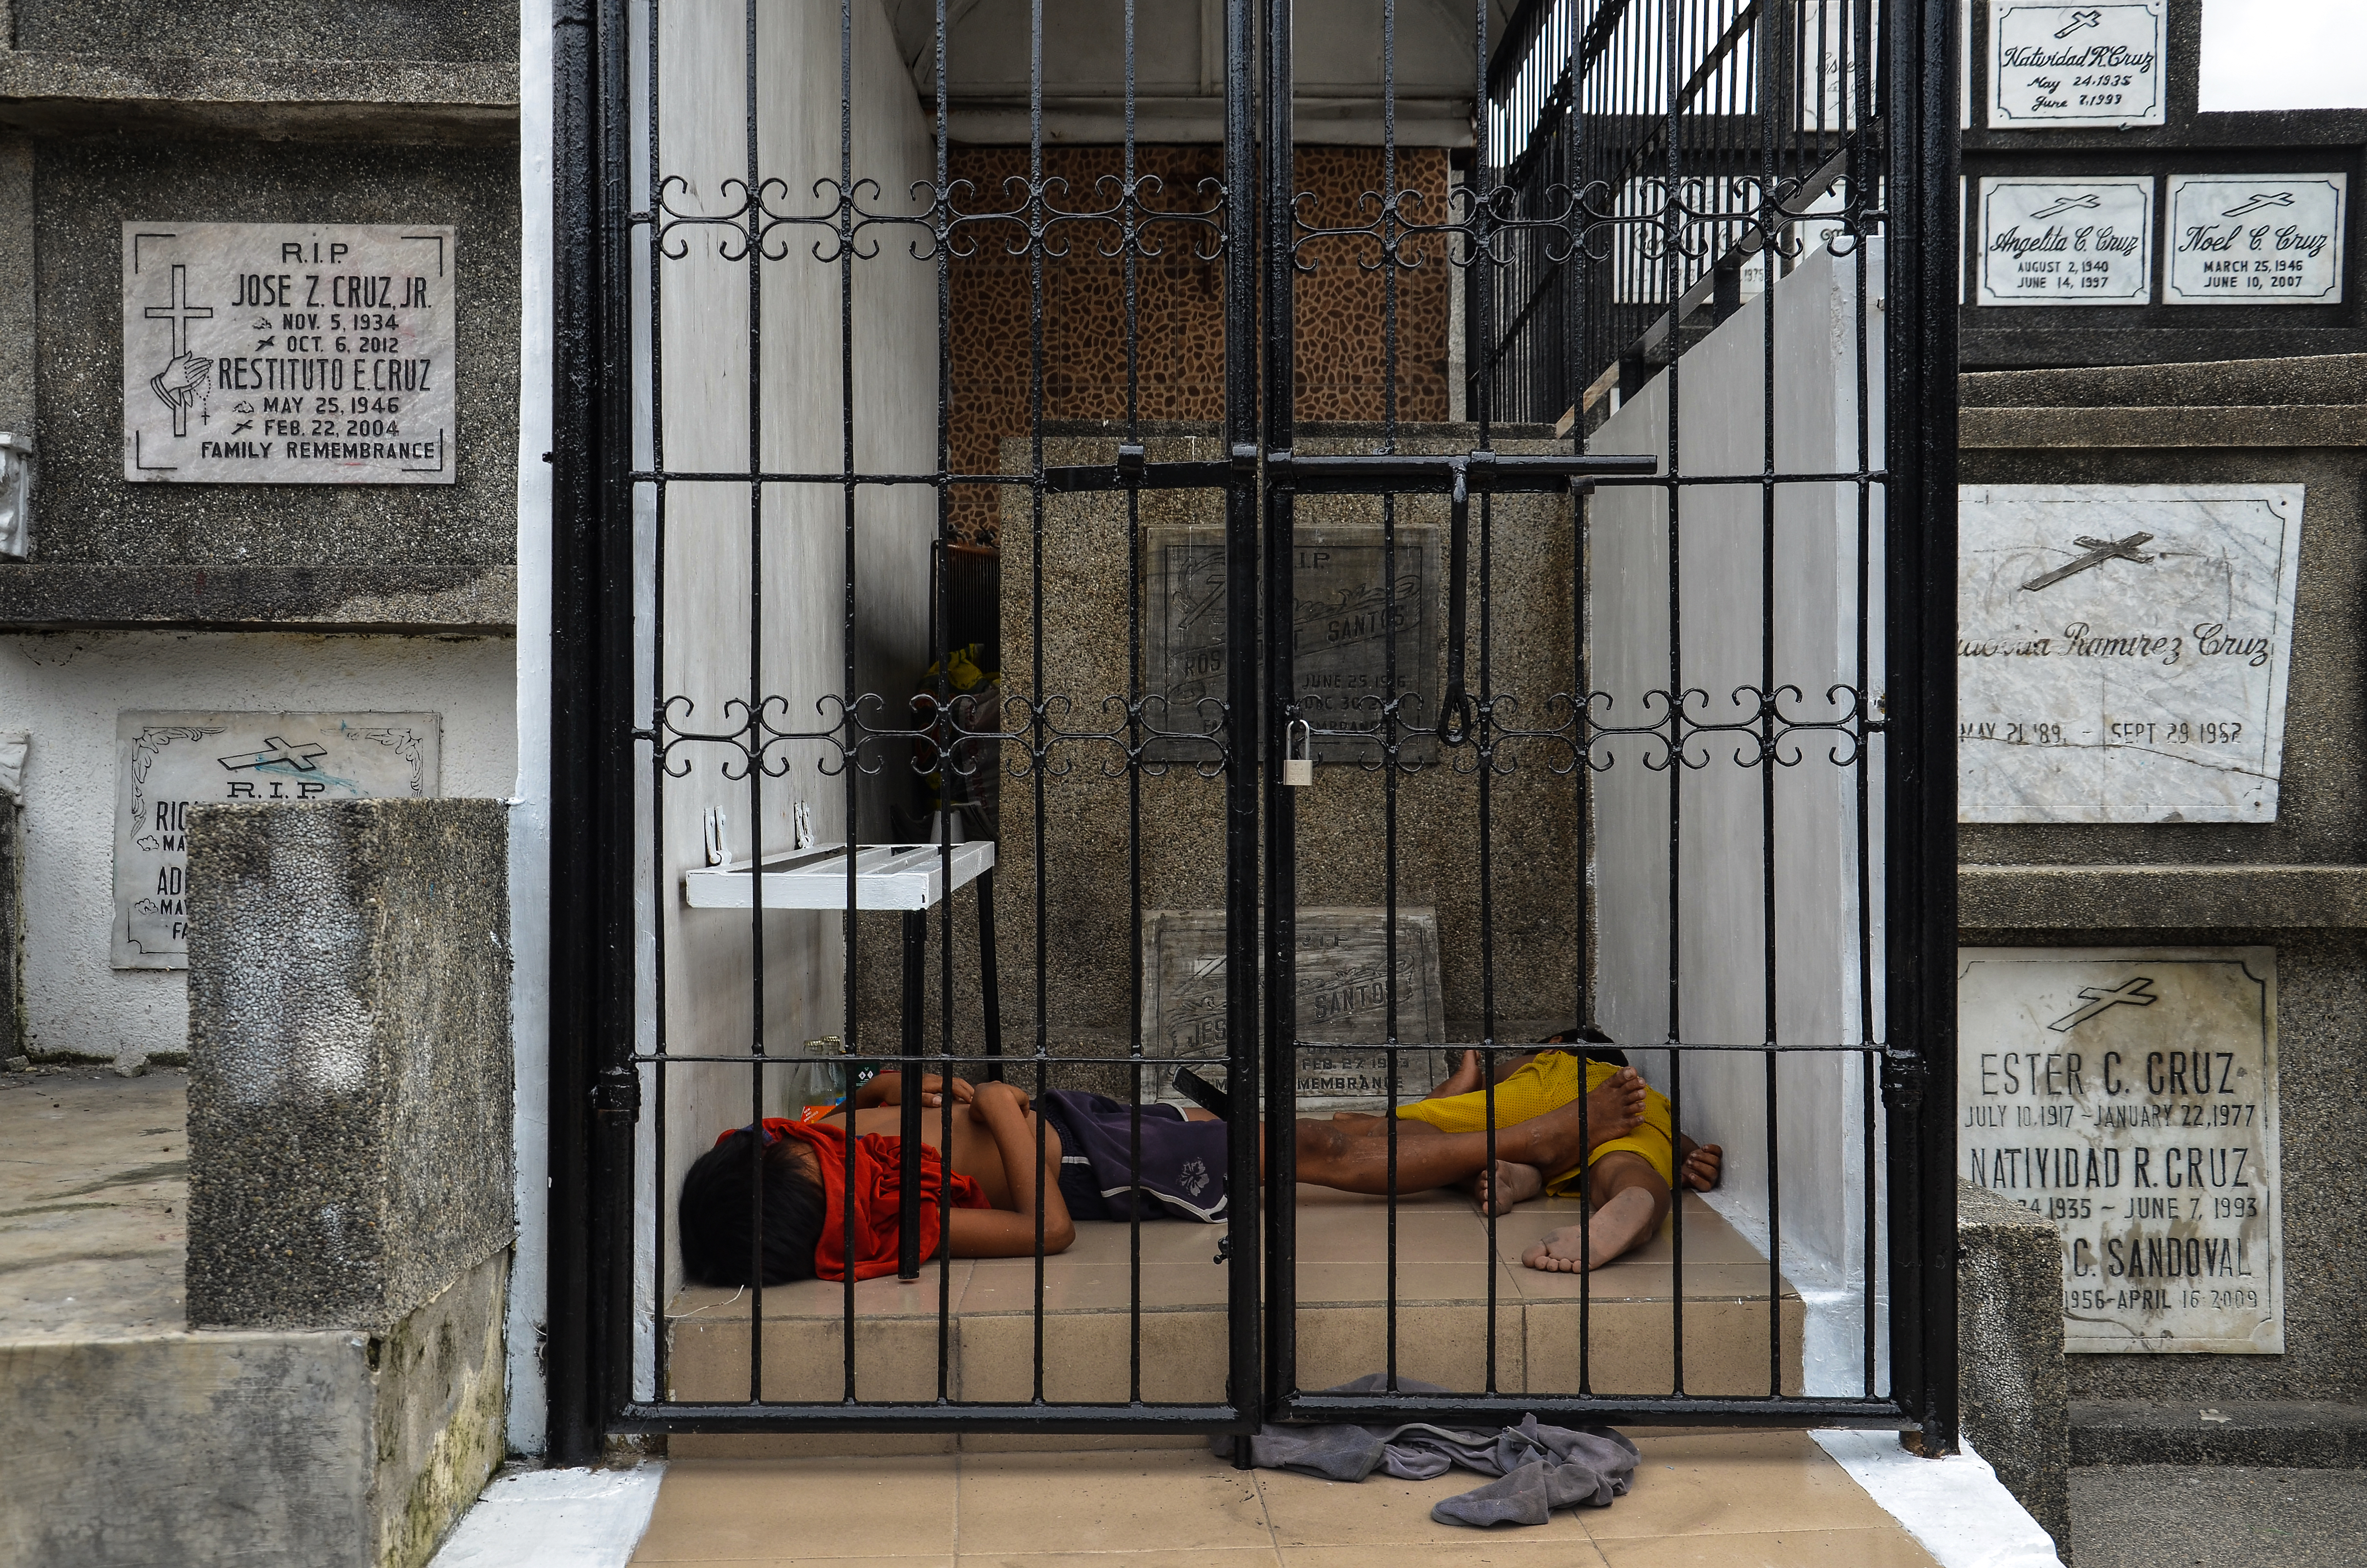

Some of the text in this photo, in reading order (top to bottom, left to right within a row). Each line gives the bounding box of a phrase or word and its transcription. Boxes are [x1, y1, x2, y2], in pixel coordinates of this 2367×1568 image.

[2003, 46, 2092, 67] Natividad
[2027, 76, 2061, 94] May
[2031, 96, 2068, 111] June
[1990, 225, 2139, 259] Angelita C. Cruz
[2178, 224, 2328, 257] Noel C. Cruz
[2018, 261, 2061, 273] AUGUST
[2203, 260, 2248, 273] MARCH
[232, 274, 432, 311] JOSE Z. CRUZ, JR.
[2017, 276, 2109, 289] JUNE 14, 1997
[2203, 276, 2303, 290] JUNE 10, 2007
[282, 314, 320, 331] NOV.
[353, 314, 400, 331] 1934
[287, 336, 399, 355] OCT. 6, 2012
[219, 358, 343, 390] RESTITUTO
[263, 397, 400, 417] MAY 25, 1946
[264, 420, 400, 439] FEB. 22, 2004
[201, 442, 434, 459] FAMILY REMEMBRANCE
[2058, 622, 2182, 665] Ramirez
[2193, 623, 2268, 666] Cruz
[1961, 722, 1995, 742] MAY
[2007, 723, 2023, 743] 21
[2112, 723, 2156, 743] SEPT
[2167, 723, 2189, 743] 29
[1314, 981, 1387, 1018] SANTO
[1302, 1058, 1336, 1070] FEB.
[1982, 1051, 2234, 1096] ESTER C. CRUZ
[1965, 1105, 2007, 1127] JULY
[2094, 1104, 2173, 1127] JANUARY
[2050, 1197, 2091, 1220] 1935
[2124, 1197, 2179, 1220] JUNE
[2190, 1198, 2202, 1221] 7,
[2215, 1197, 2257, 1219] 1993
[2073, 1237, 2252, 1278] C. SANDOVAL
[2211, 1290, 2258, 1310] 2009
